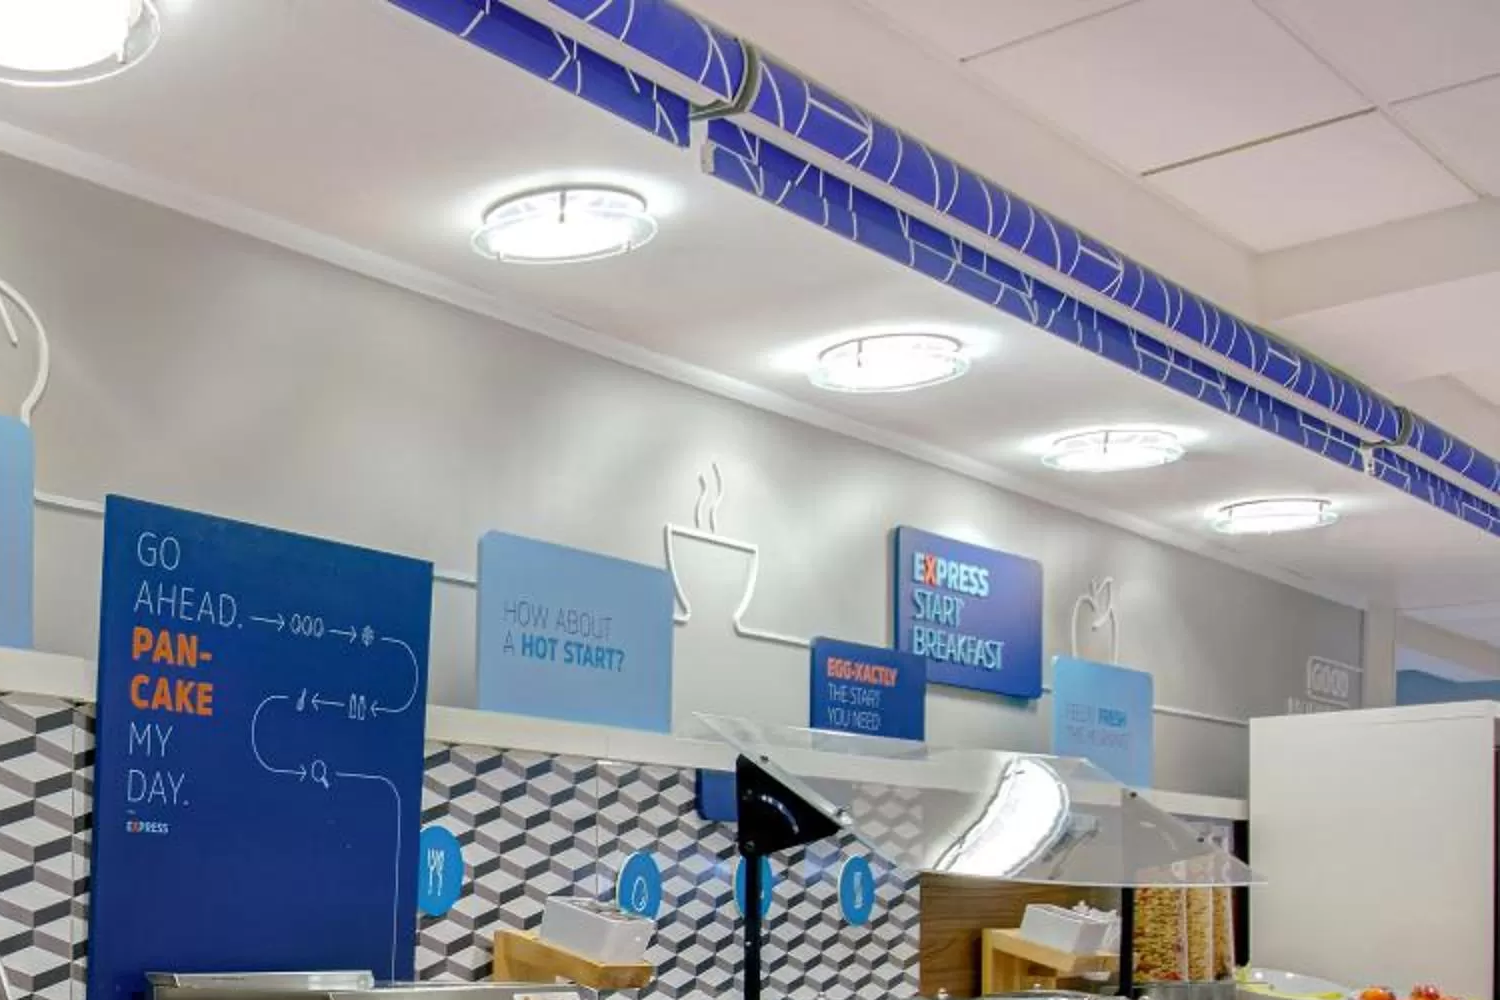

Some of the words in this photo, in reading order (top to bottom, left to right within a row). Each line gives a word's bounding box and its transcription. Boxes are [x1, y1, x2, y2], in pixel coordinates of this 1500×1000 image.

[137, 532, 181, 571] GO
[912, 551, 989, 597] EXPRESS
[133, 579, 244, 630] AHEAD.
[503, 600, 549, 629] HOW
[556, 607, 613, 640] ABOUT
[911, 588, 963, 628] START
[132, 626, 213, 668] PAN-
[503, 629, 515, 655] A
[521, 632, 558, 662] HOT
[563, 641, 626, 673] START?
[912, 625, 1005, 671] BREAKFAST
[130, 674, 213, 717] CAKE
[128, 721, 174, 757] MY
[127, 769, 190, 806] DAY.
